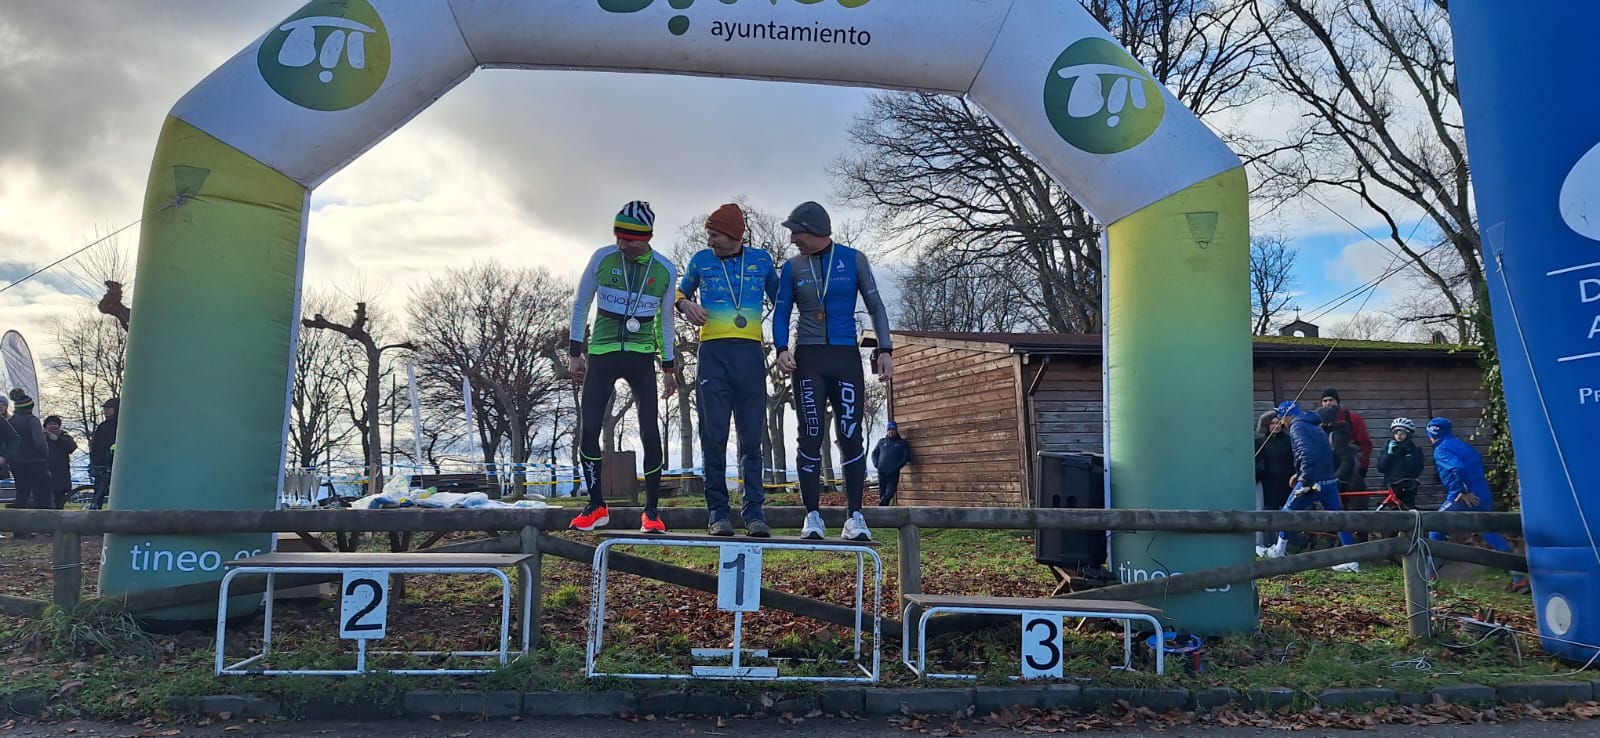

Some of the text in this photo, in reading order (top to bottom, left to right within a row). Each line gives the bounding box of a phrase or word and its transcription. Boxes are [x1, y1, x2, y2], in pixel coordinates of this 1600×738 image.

[711, 19, 872, 46] ayuntamiento
[802, 379, 819, 436] LIMITED
[344, 578, 384, 632] 2
[723, 553, 746, 606] 1
[1025, 618, 1060, 670] 3
